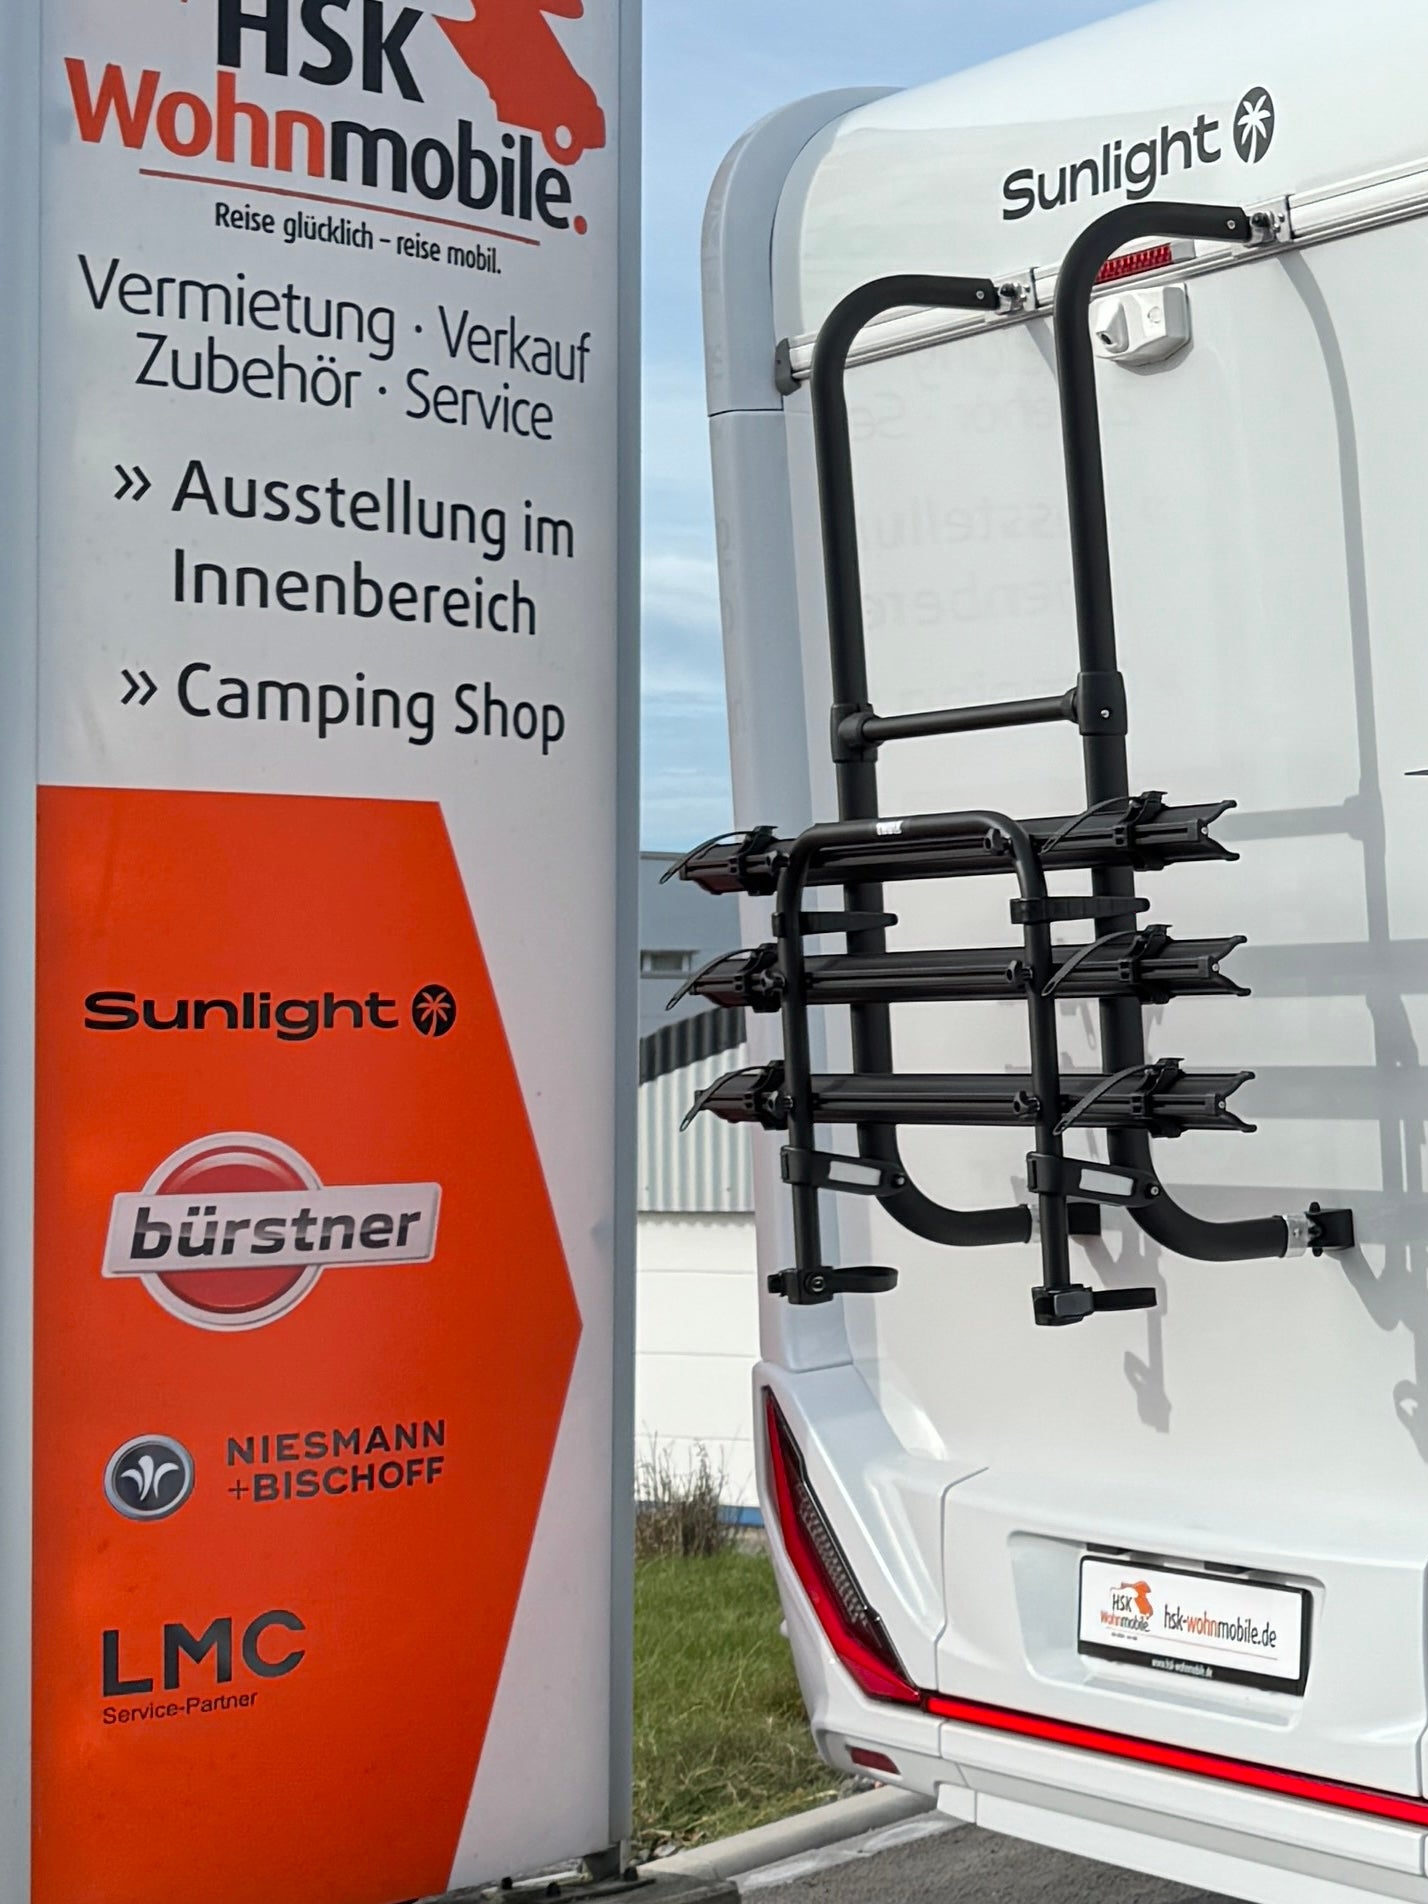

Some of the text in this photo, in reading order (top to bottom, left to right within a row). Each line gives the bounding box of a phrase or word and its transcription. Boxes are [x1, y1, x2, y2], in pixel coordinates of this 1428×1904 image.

[1002, 114, 1222, 221] Sunlight
[214, 201, 276, 234] Reise
[283, 210, 374, 250] glücklich
[396, 232, 441, 262] reise
[447, 243, 502, 275] mobil.
[77, 253, 591, 384] Vermietung Verkauf
[135, 331, 554, 440] Zubehör Service
[171, 459, 575, 562] Ausstellung im
[173, 547, 537, 637] Innenbereich
[177, 661, 566, 755] Camping Shop
[83, 991, 399, 1041] Sunlight
[128, 1206, 423, 1259] bürstner
[227, 1418, 446, 1467] NIESMANN
[227, 1455, 445, 1503] +BISCHOFF
[1112, 1593, 1133, 1613] HSK
[1163, 1602, 1277, 1648] hsk-wohnmobile.de
[102, 1609, 306, 1698] LMC
[102, 1691, 259, 1726] Service-Partner
